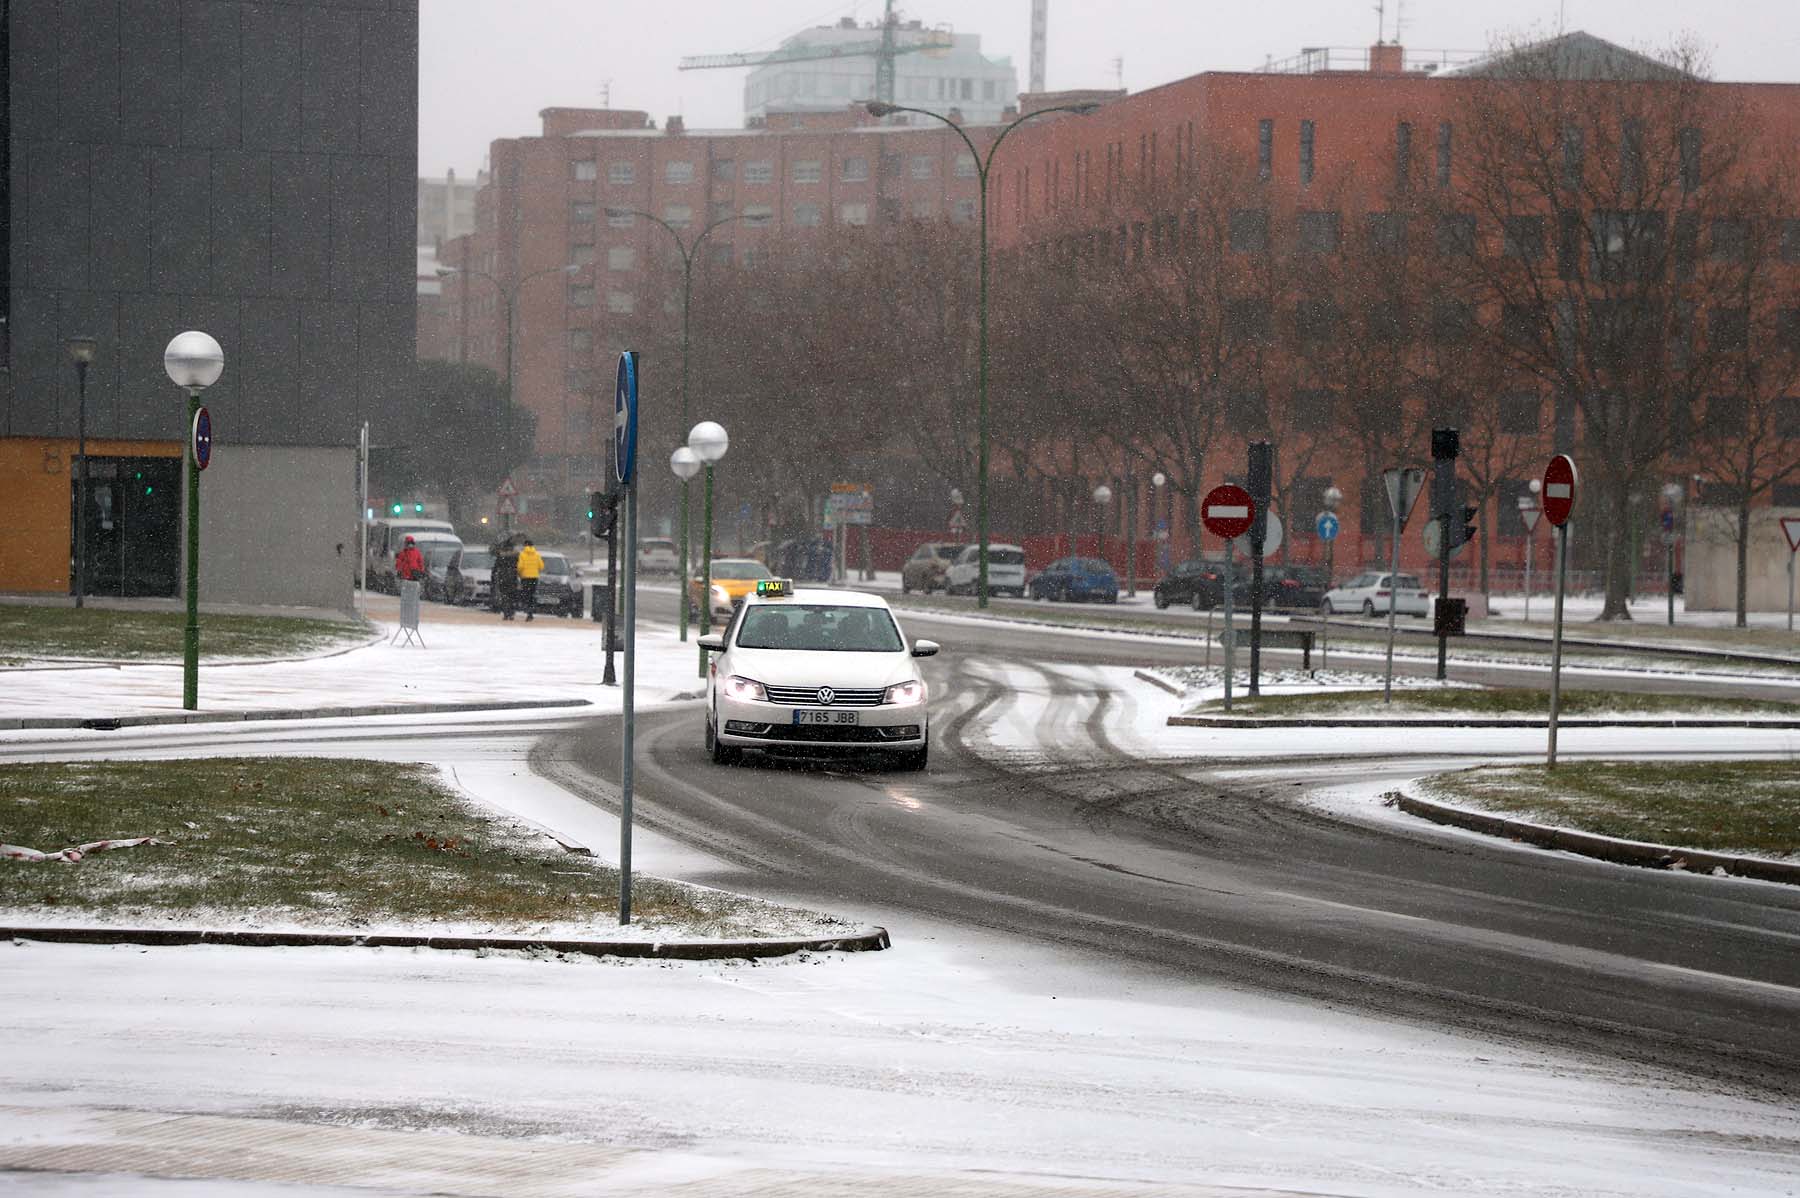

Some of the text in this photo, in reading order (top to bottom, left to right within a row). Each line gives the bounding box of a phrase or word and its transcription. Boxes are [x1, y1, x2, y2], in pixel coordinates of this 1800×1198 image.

[765, 582, 783, 591] TAXI
[800, 712, 855, 724] 7165 JBB
